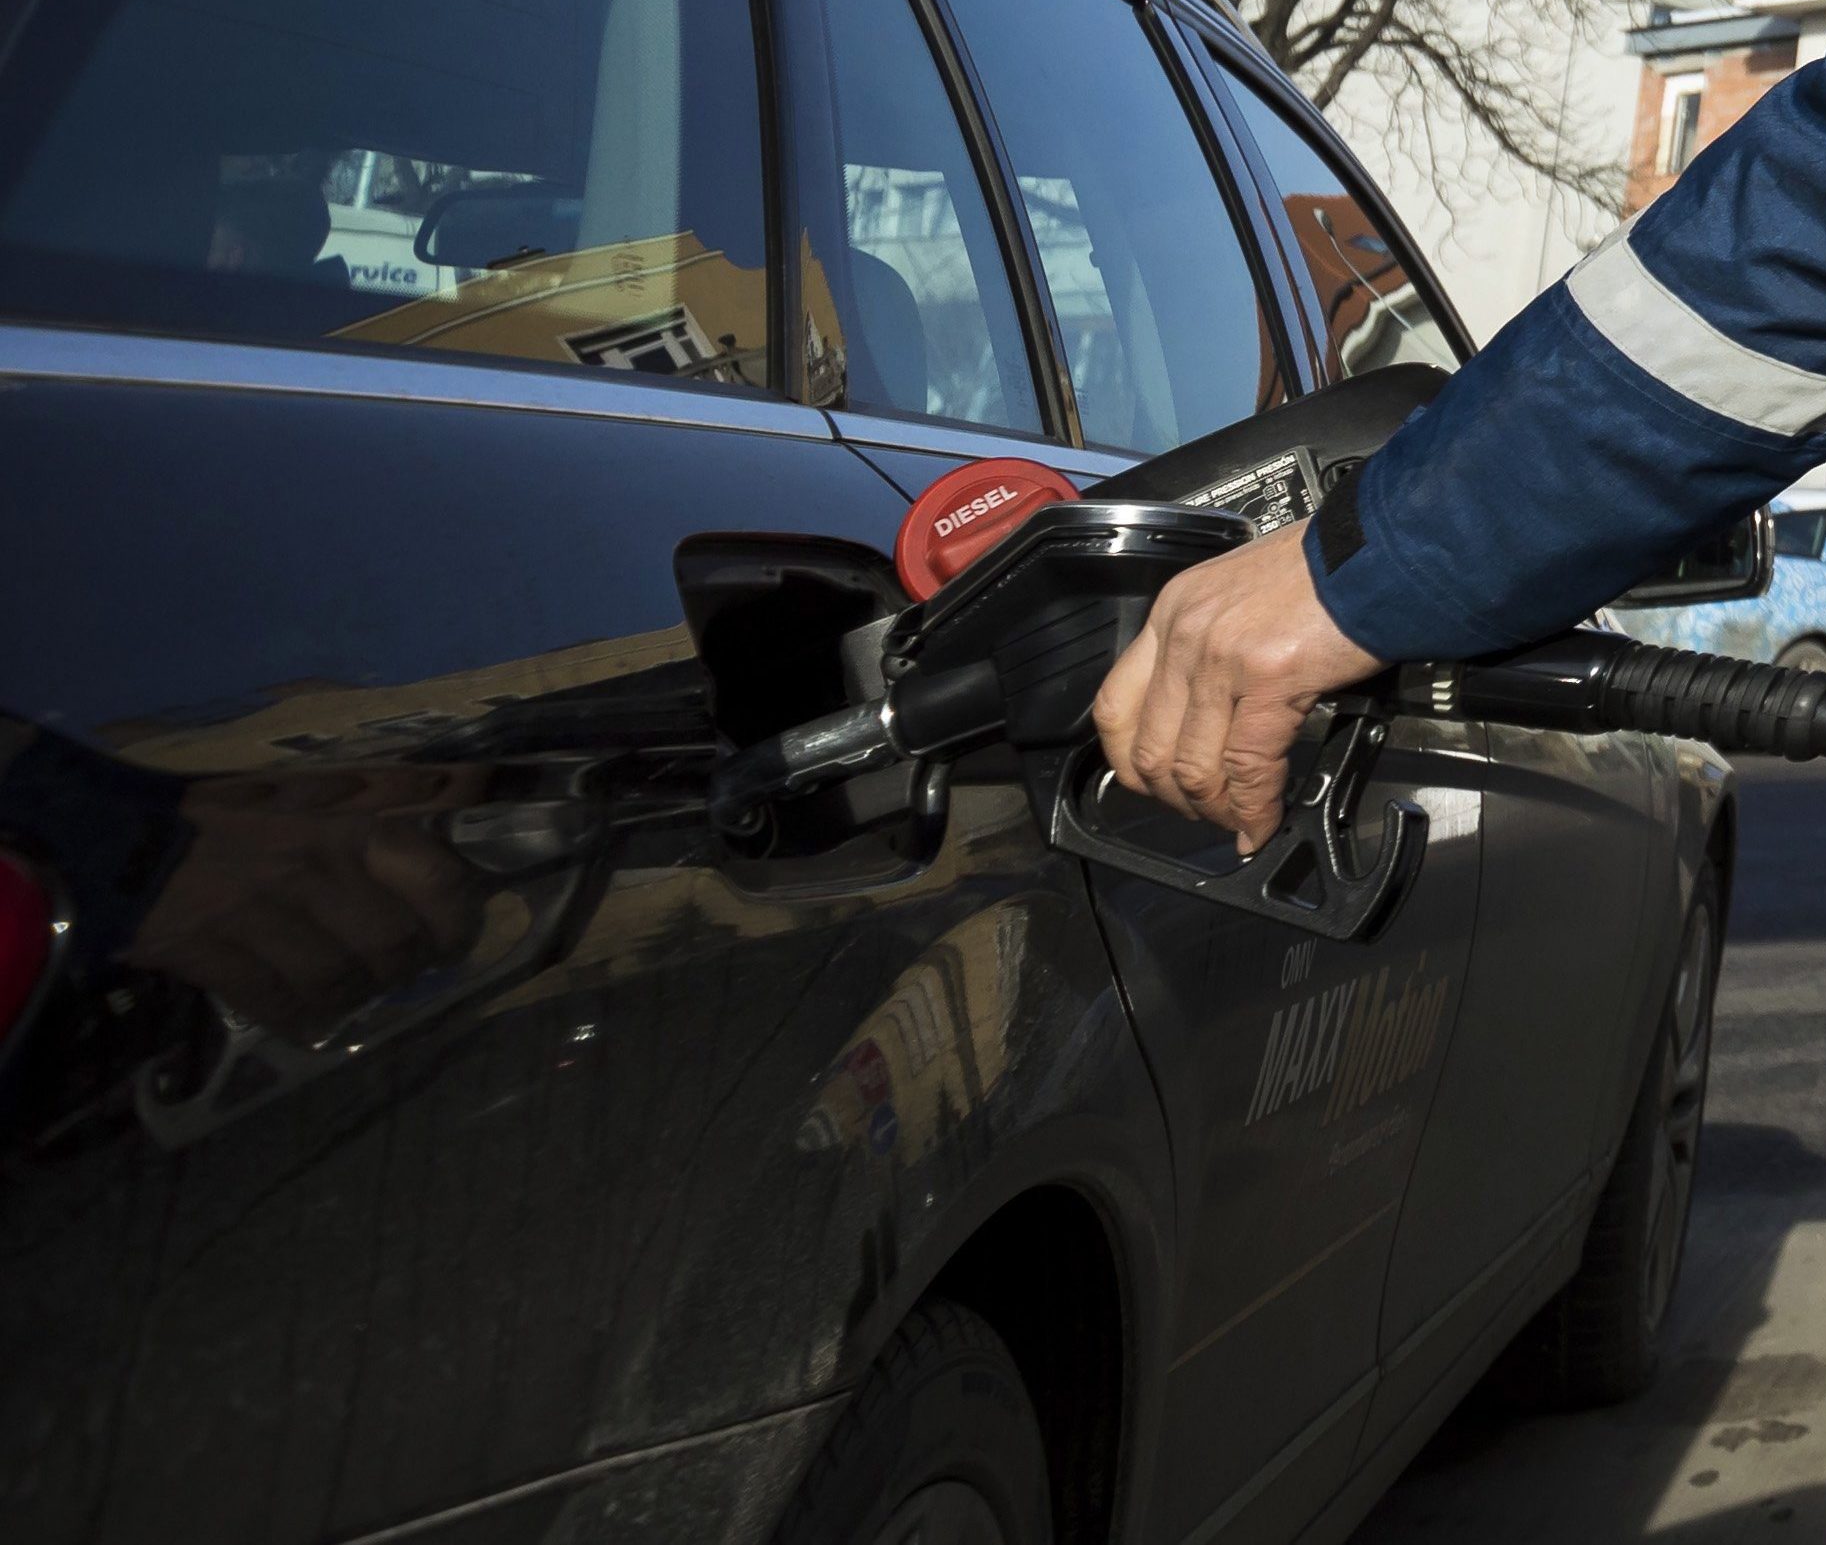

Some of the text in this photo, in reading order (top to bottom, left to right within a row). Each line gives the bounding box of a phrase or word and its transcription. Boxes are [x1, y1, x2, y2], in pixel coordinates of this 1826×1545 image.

[351, 261, 417, 284] rvice
[934, 485, 1018, 537] DIESEL
[1281, 938, 1317, 989] OMV
